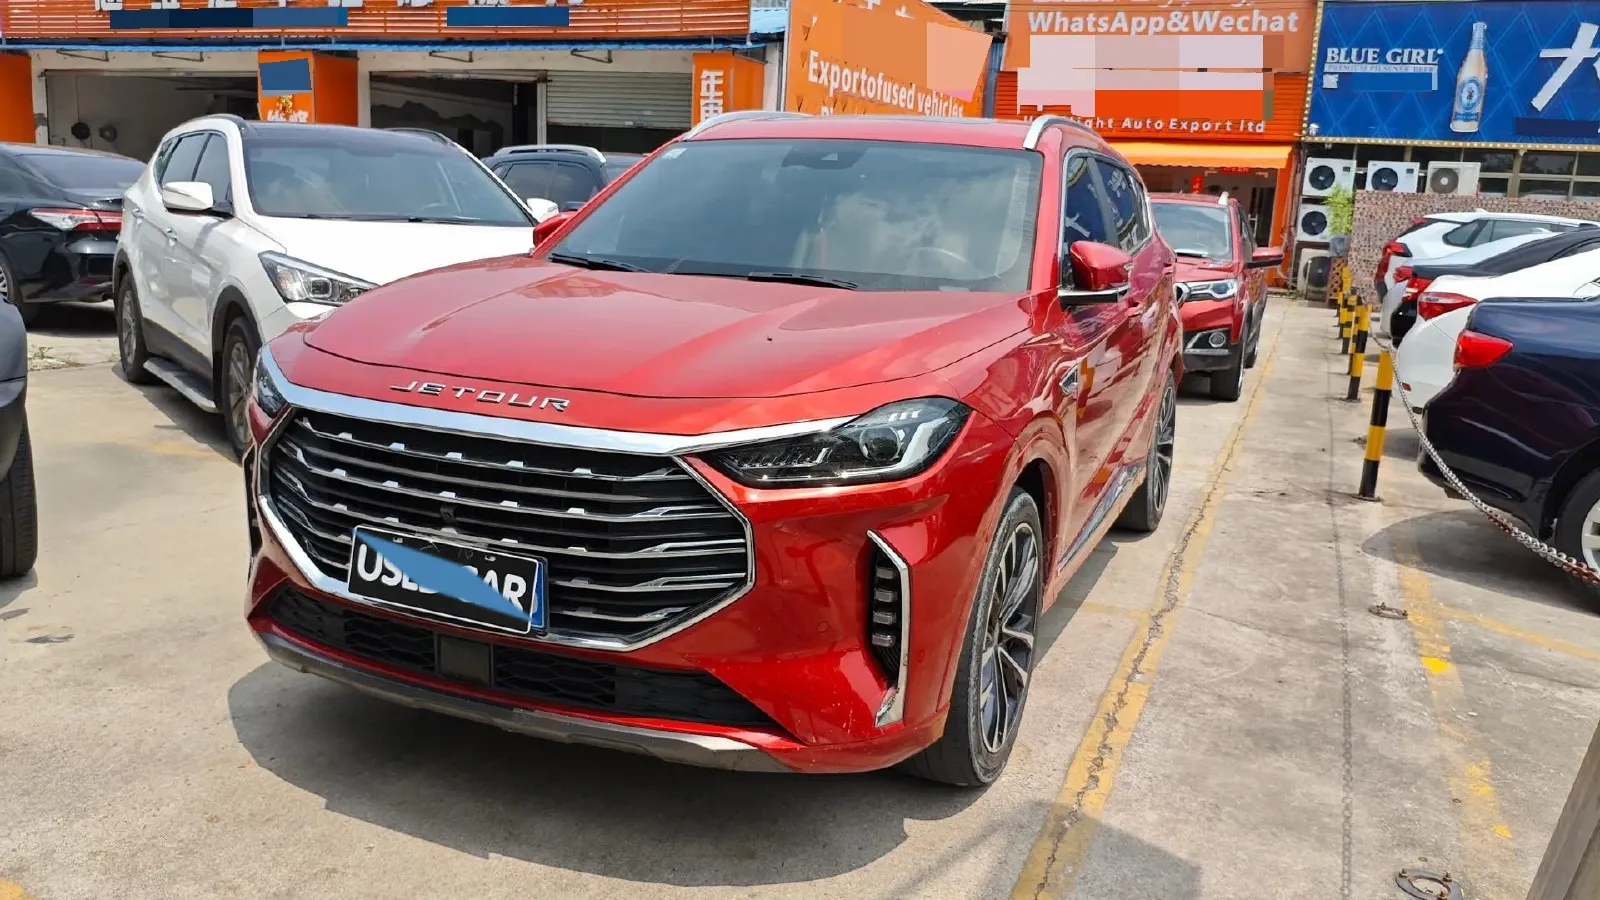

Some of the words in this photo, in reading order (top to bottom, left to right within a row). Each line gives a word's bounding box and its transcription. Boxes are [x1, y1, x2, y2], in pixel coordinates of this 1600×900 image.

[1028, 10, 1299, 35] WhatsApp&Wechat
[1326, 47, 1380, 63] BLUE
[1385, 48, 1439, 64] GIRL
[1121, 118, 1163, 129] Auto
[1169, 118, 1232, 133] Export
[390, 381, 571, 412] JETOUR
